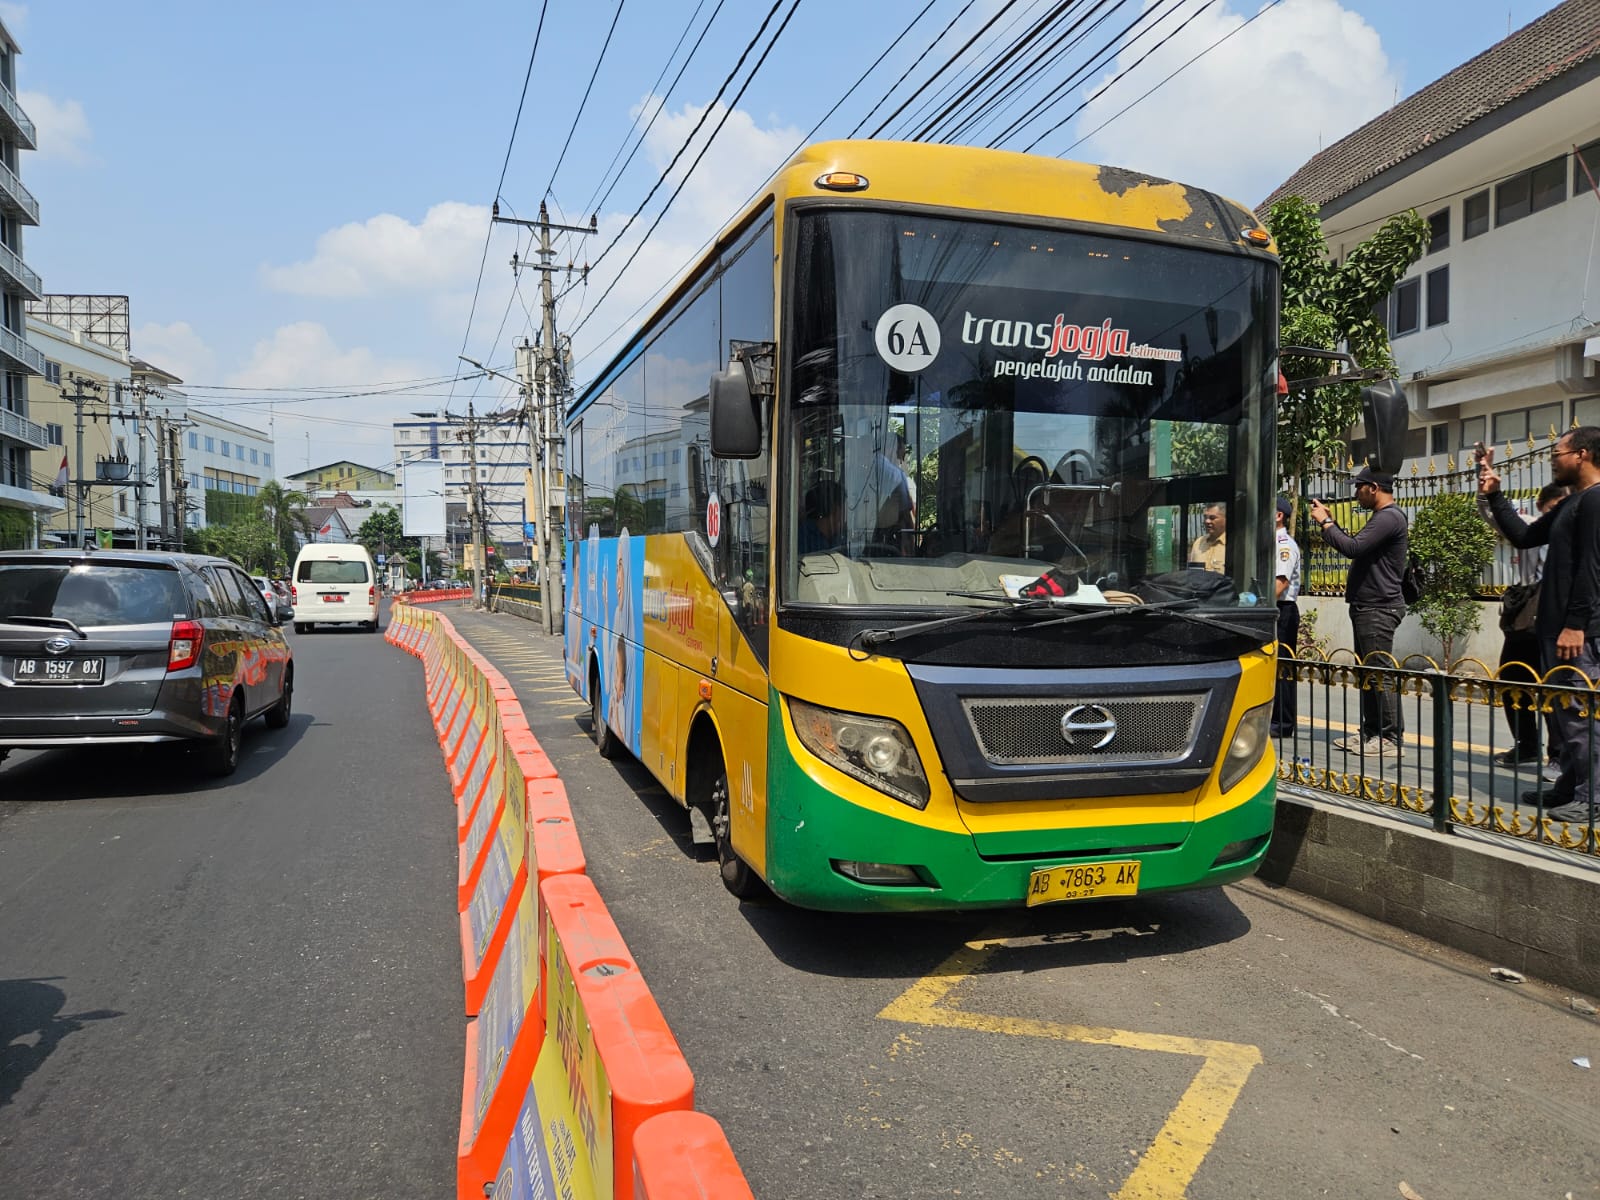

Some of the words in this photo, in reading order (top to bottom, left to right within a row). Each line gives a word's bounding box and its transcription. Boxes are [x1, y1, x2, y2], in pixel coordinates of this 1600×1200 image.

[887, 318, 933, 357] 6A
[1086, 363, 1154, 386] andalan
[708, 502, 719, 537] 86
[19, 660, 36, 674] AB
[45, 661, 74, 674] 1597
[1032, 873, 1050, 895] AB
[1064, 866, 1105, 889] 7863
[1116, 865, 1138, 884] AK
